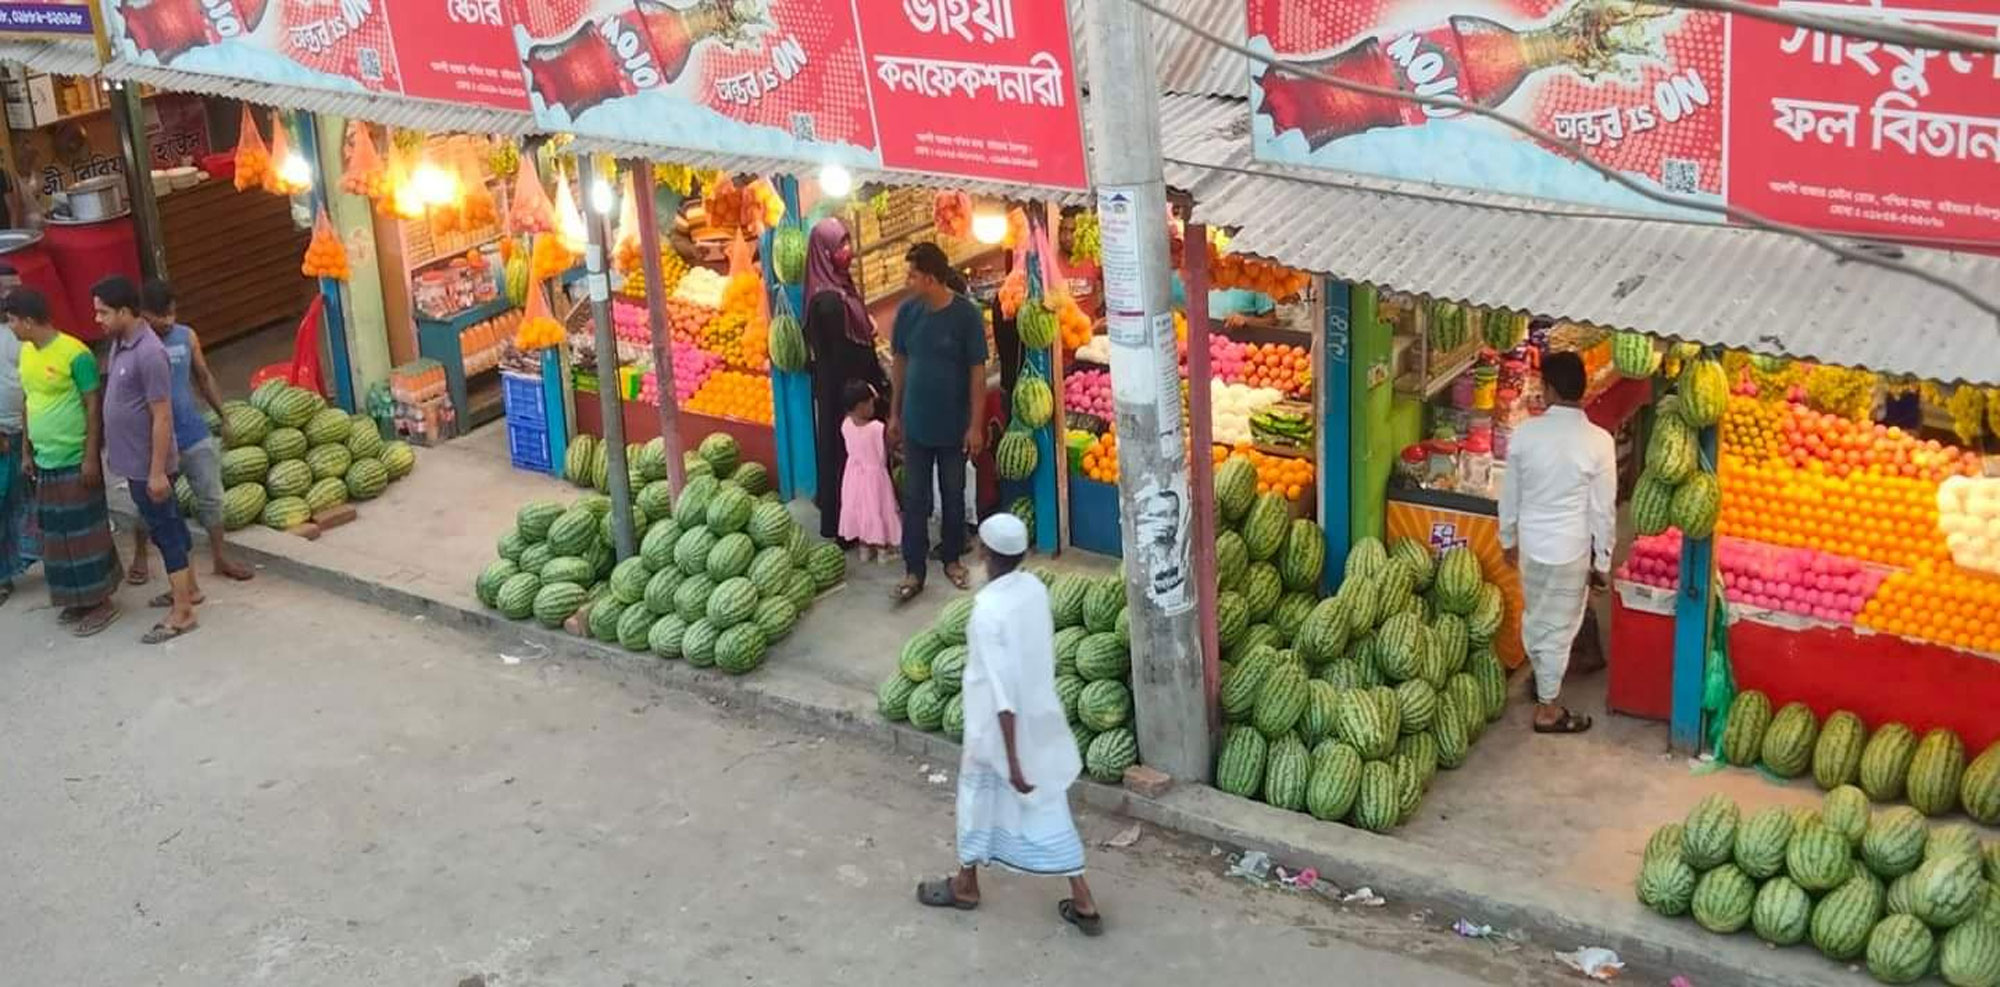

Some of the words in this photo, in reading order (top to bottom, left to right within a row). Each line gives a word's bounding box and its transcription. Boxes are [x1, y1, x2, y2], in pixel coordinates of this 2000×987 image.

[600, 14, 660, 89] MOJO
[771, 32, 808, 82] ON
[873, 51, 1065, 108] কনফেকশনারী
[1386, 31, 1467, 120] MOJO
[1553, 106, 1624, 148] অন্তর
[1654, 67, 1711, 123] ON
[1770, 97, 1861, 148] ফল
